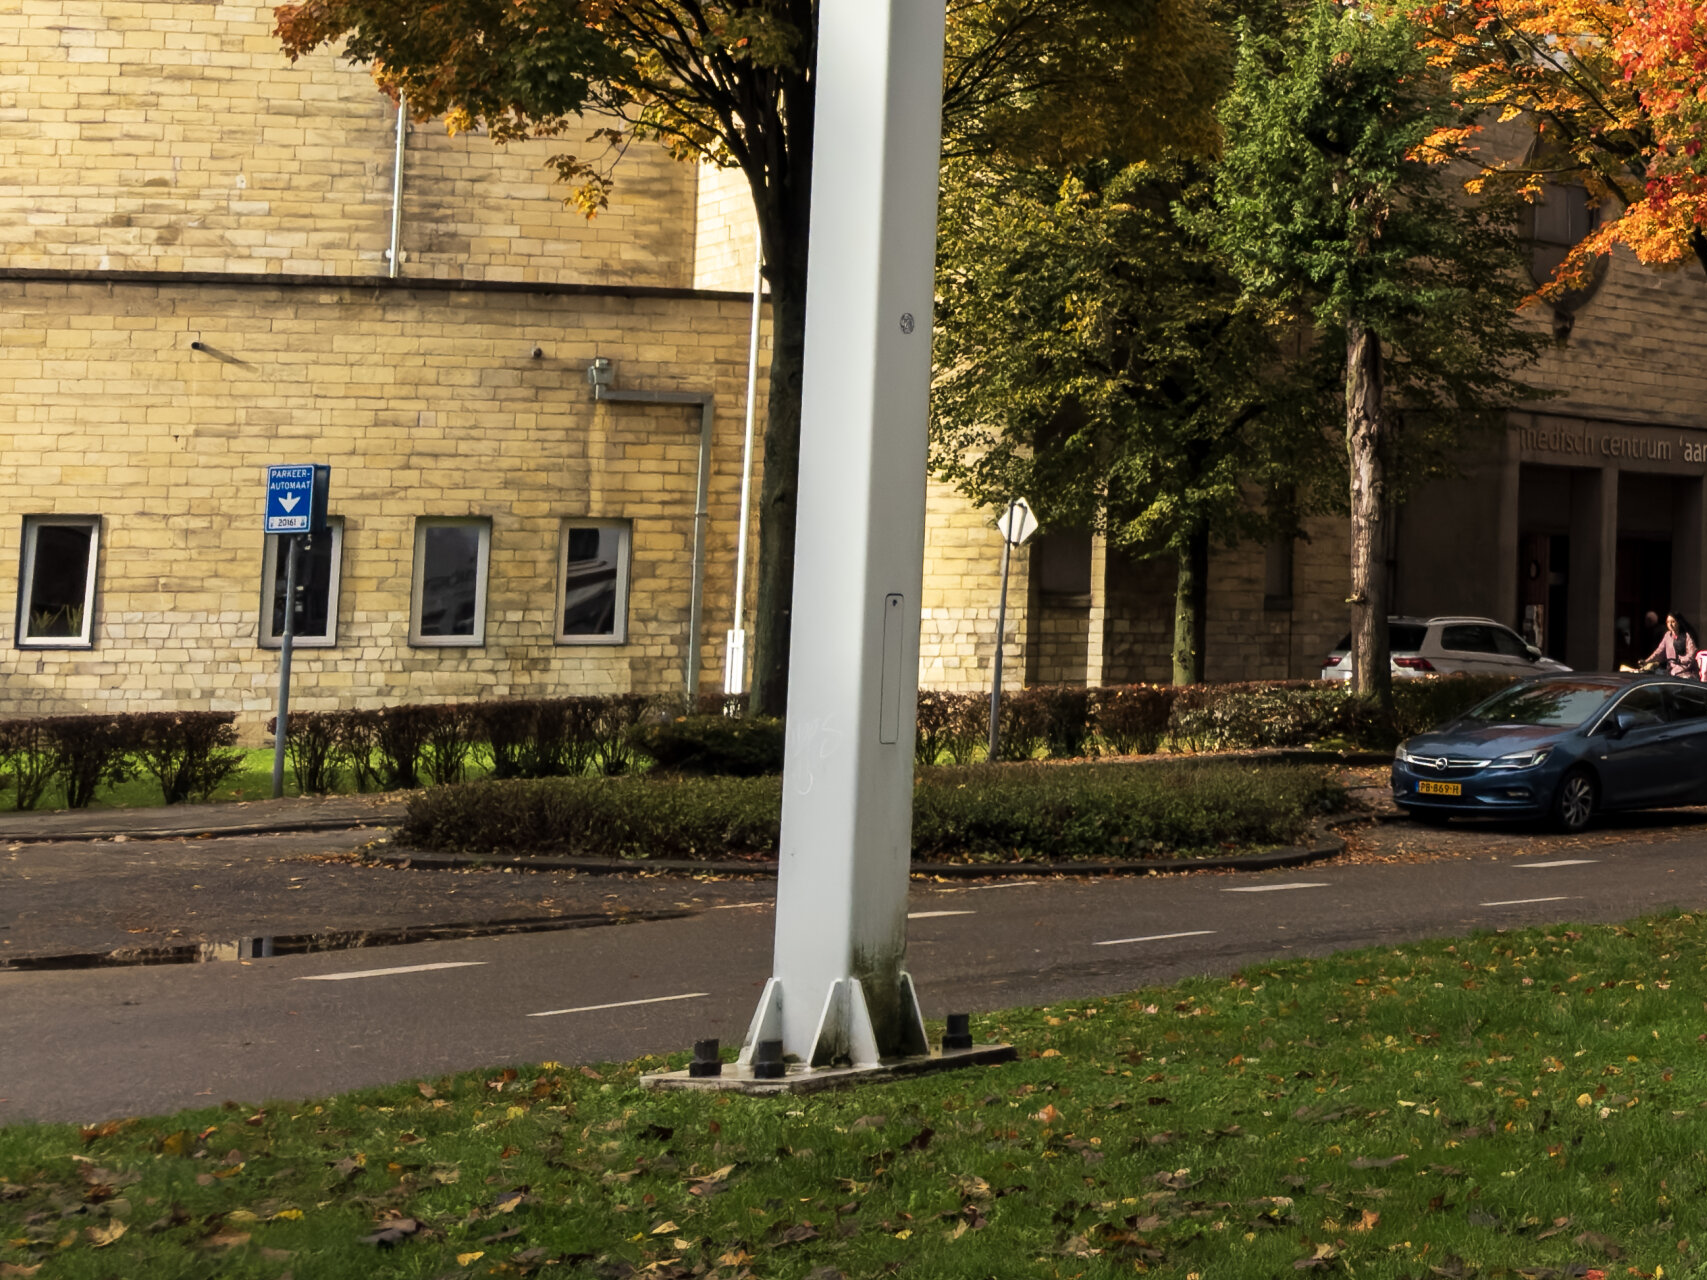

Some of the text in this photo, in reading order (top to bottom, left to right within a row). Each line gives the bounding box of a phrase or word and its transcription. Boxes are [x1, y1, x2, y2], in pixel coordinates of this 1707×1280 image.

[1519, 426, 1594, 456] medisch
[1600, 434, 1672, 460] centrum
[271, 469, 311, 478] PARKEER-
[270, 480, 311, 490] AUTOMAAT
[1420, 782, 1460, 794] PB-869-H
